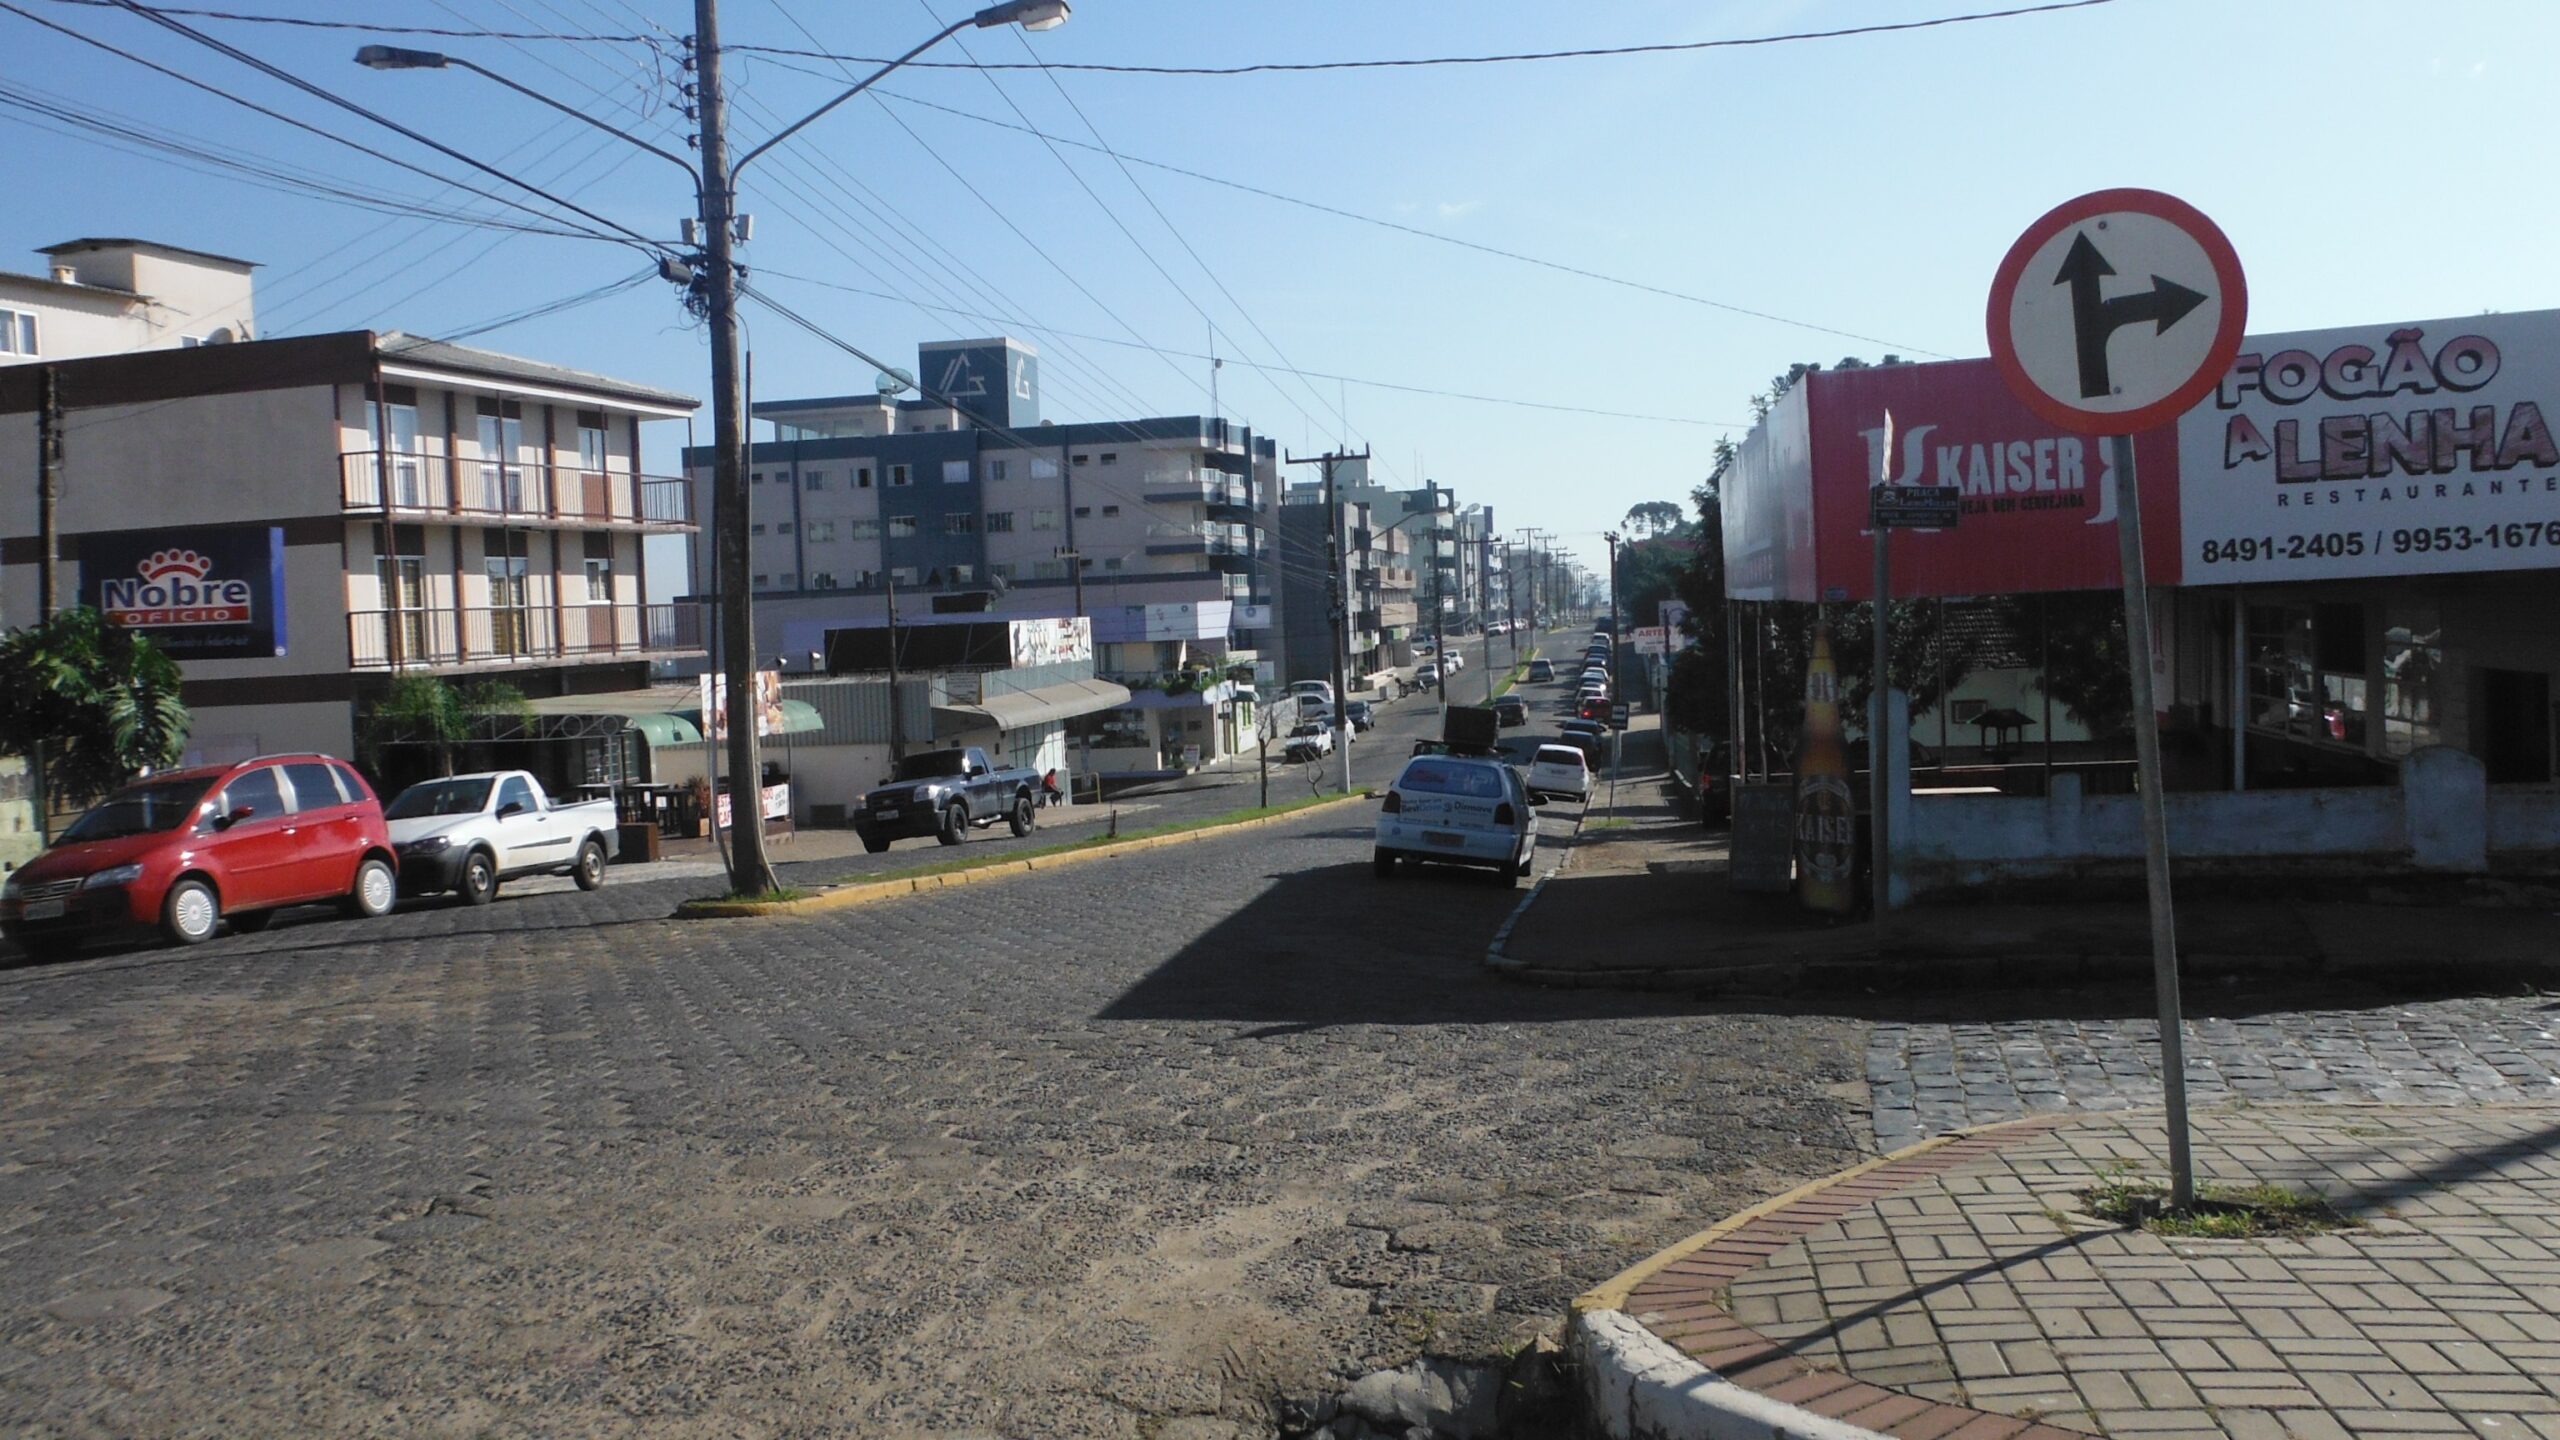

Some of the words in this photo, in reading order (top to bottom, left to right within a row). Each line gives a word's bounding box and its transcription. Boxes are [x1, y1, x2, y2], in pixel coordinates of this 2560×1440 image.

[2216, 327, 2501, 409] FOGÃO
[2274, 401, 2560, 483] LENHA
[1936, 437, 2085, 496] KAISER
[1960, 499, 1988, 514] VEJA
[2277, 477, 2558, 506] RESTAURANTE
[2202, 532, 2365, 564] 8491-2405
[2393, 519, 2560, 553] 9953-1676
[103, 577, 249, 608] Nobre
[125, 608, 230, 624] OFICIO
